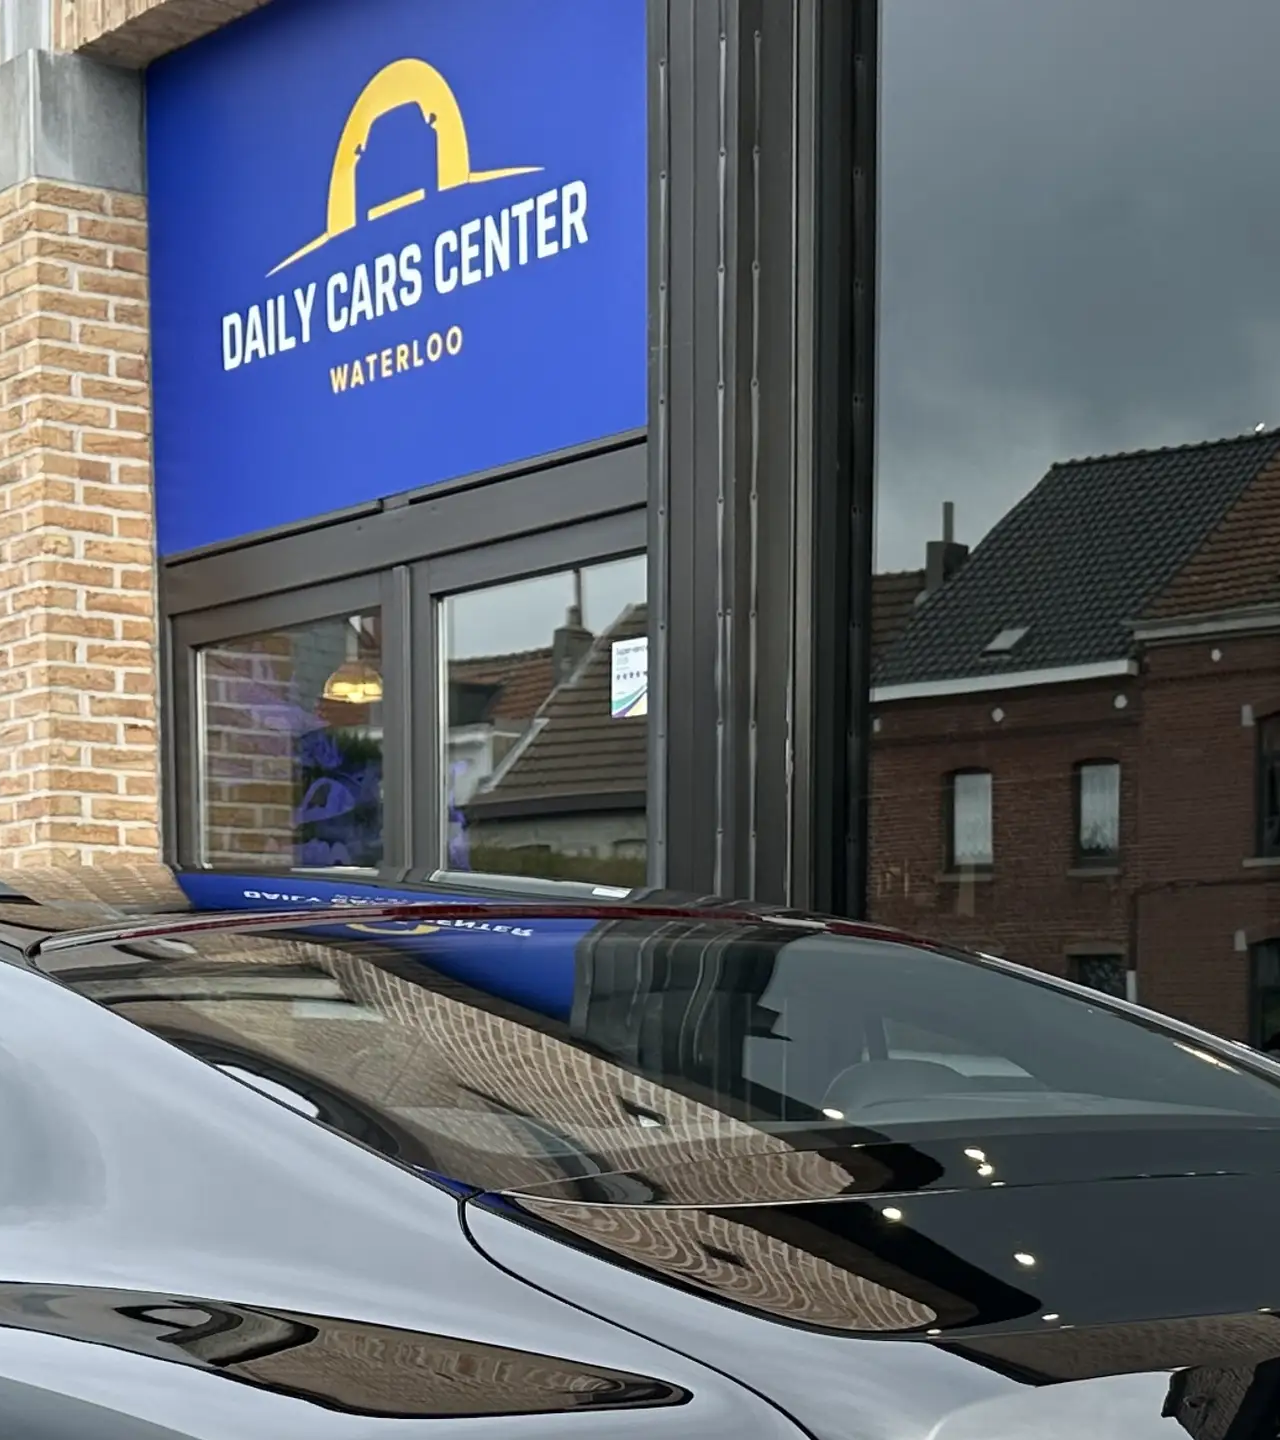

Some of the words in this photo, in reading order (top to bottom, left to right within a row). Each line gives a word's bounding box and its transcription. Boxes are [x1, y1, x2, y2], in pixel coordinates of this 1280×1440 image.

[222, 282, 315, 371] DAILY
[326, 243, 421, 333] CARS
[434, 180, 588, 295] CENTER
[330, 325, 463, 393] WATERLOO
